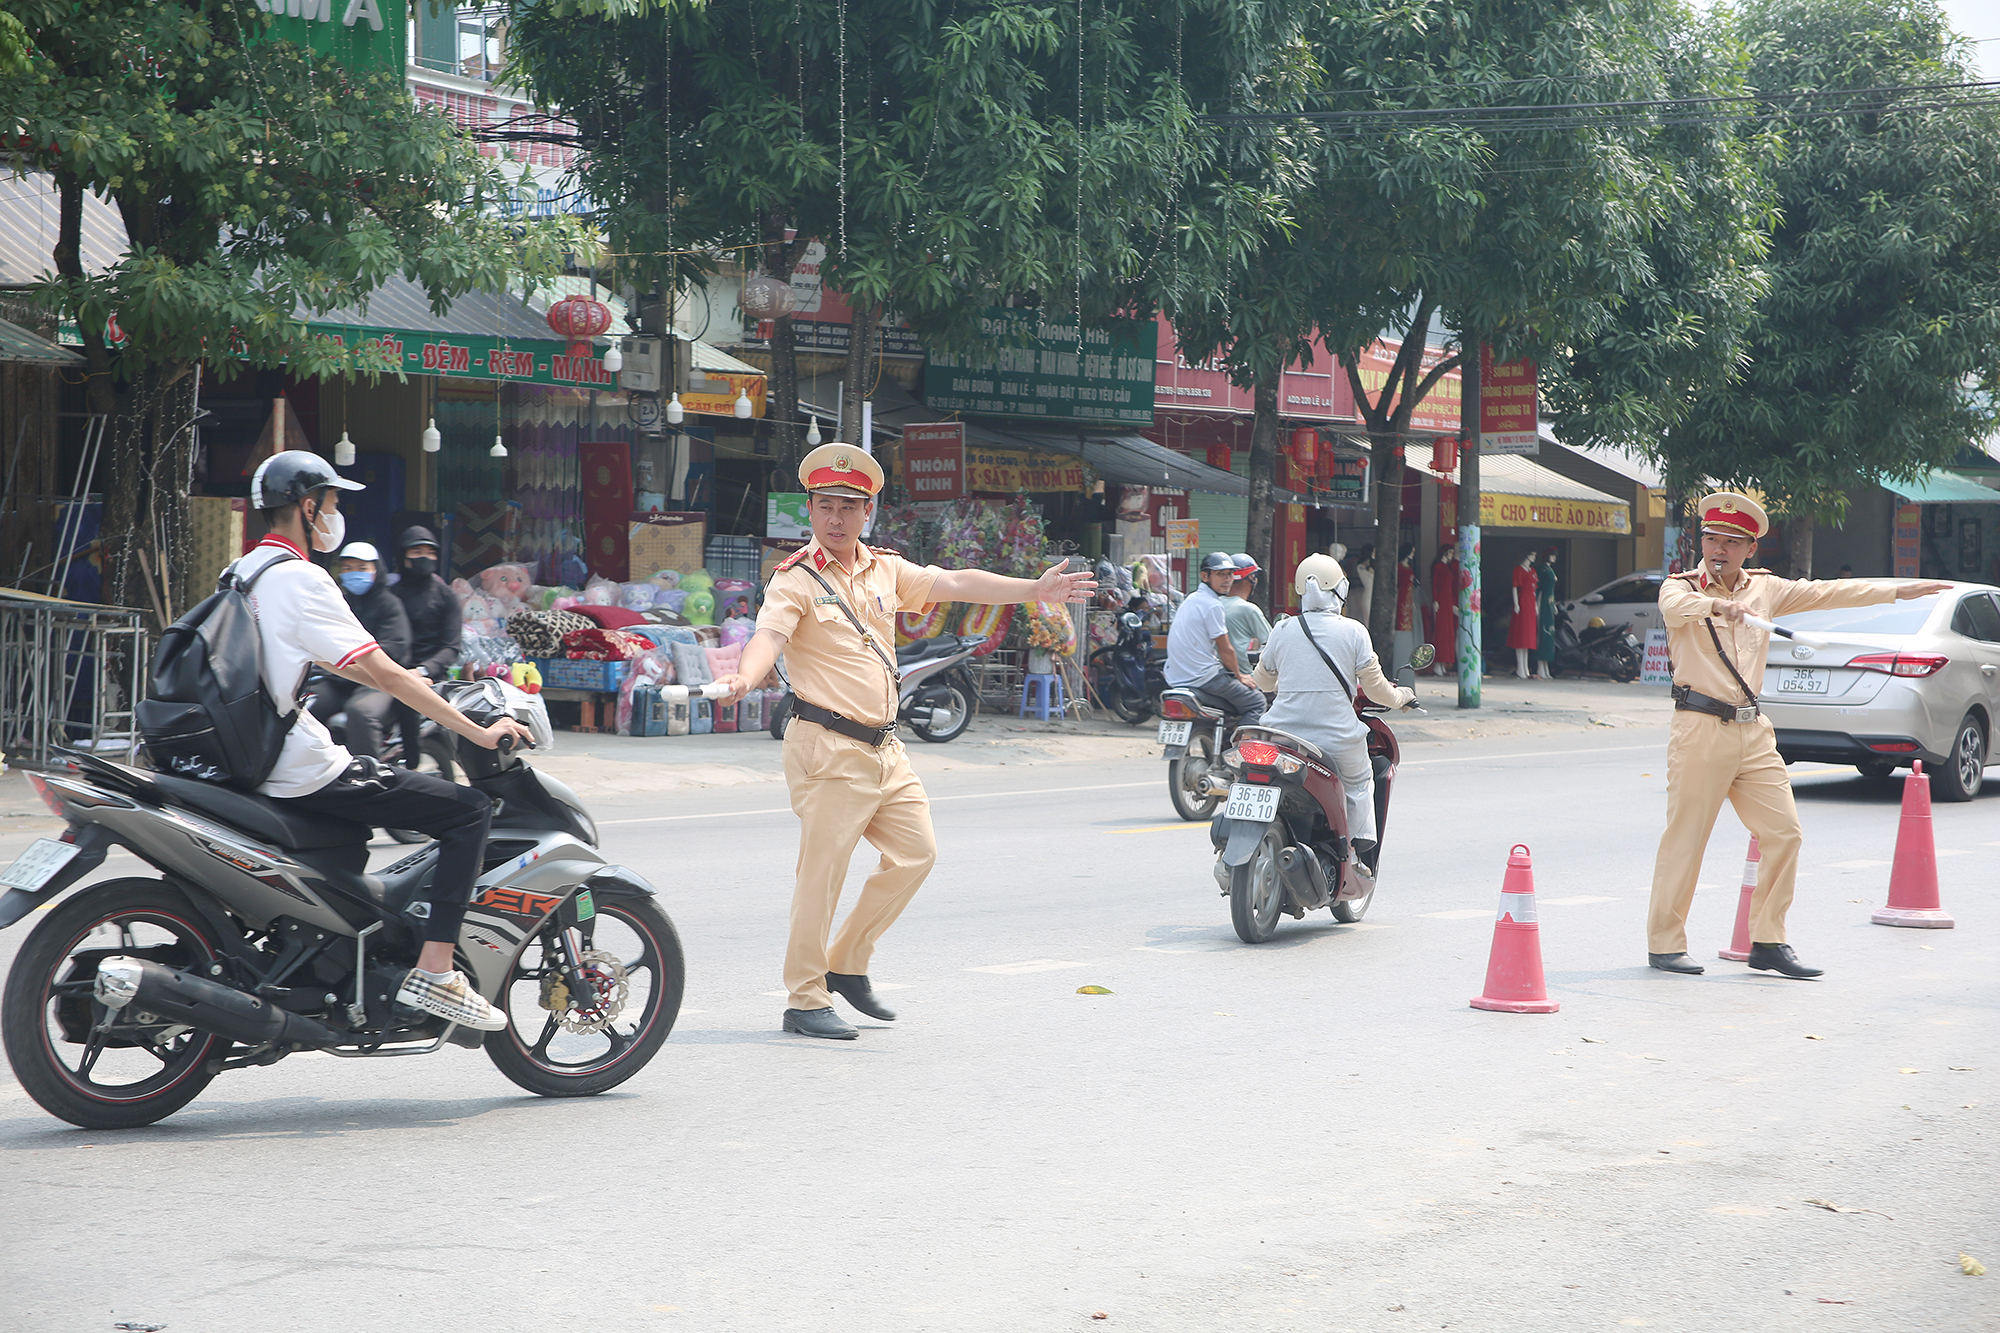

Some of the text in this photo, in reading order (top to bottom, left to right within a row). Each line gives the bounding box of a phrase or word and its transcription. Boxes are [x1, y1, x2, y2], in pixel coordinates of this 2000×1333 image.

[422, 340, 470, 375] ĐỆM
[1078, 387, 1098, 401] THEO
[910, 457, 957, 473] NHÔM
[915, 475, 953, 491] KÍNH
[1500, 503, 1527, 522] CHO
[1530, 501, 1564, 524] THUÊ
[1566, 503, 1584, 526] ÁO
[1586, 506, 1611, 528] DÀI
[1792, 668, 1815, 680] 36K
[1782, 679, 1823, 692] 054.97
[1306, 761, 1332, 778] VISION
[1236, 786, 1273, 803] 36-B6
[1228, 802, 1273, 819] 606.10
